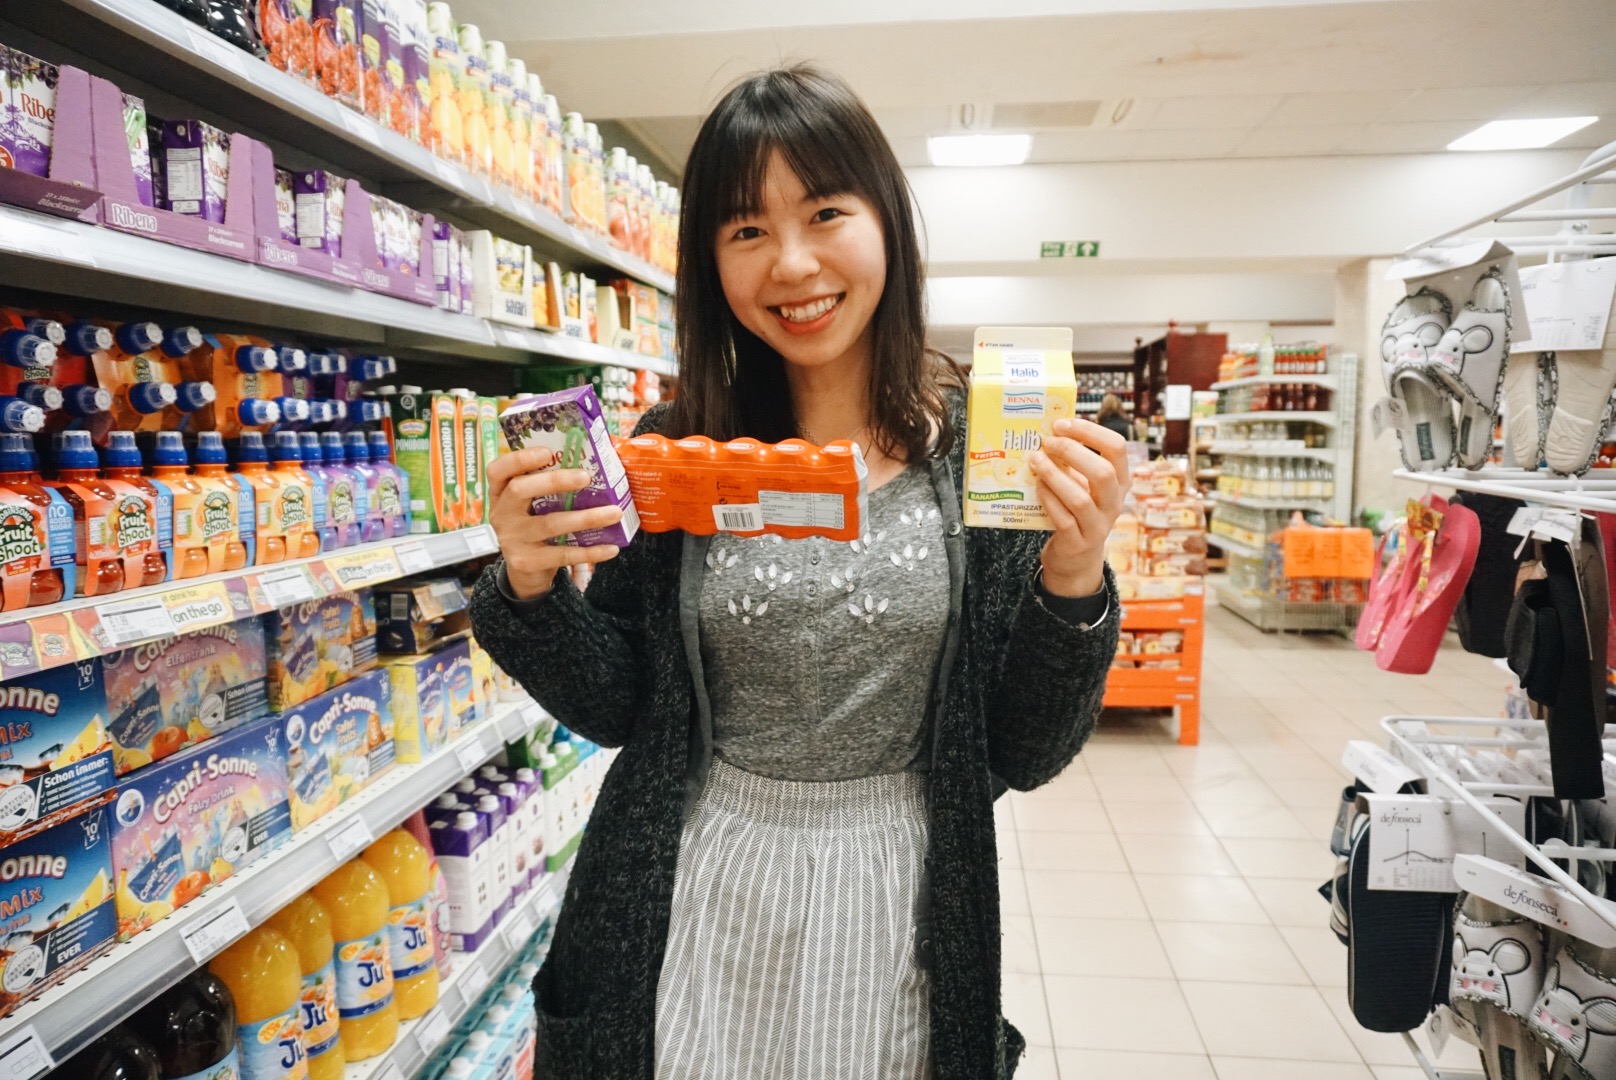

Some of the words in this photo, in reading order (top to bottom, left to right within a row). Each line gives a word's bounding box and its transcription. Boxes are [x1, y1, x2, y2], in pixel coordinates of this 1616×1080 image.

[112, 203, 157, 233] Ribena
[1007, 396, 1040, 404] BENNA
[442, 427, 455, 483] POMODORO
[464, 427, 475, 482] POMODORO
[975, 451, 1001, 459] FRISK
[970, 492, 999, 500] BANANA
[1000, 492, 1023, 500] CARAMEL
[206, 507, 227, 521] Fruit
[991, 503, 1043, 511] IPPASTURIZZAT
[120, 511, 146, 531] Fruit
[204, 521, 230, 536] Shoot
[118, 526, 150, 545] Shoot
[173, 611, 188, 623] on
[187, 605, 208, 618] the
[207, 602, 222, 616] go
[79, 664, 93, 676] 10
[309, 692, 376, 745] Capri-Sonne
[44, 771, 75, 788] Schon
[153, 754, 258, 824] Capri-Sonne
[85, 822, 98, 835] 10
[253, 831, 268, 845] EVER
[1, 887, 43, 919] Mix
[57, 942, 81, 964] EVER
